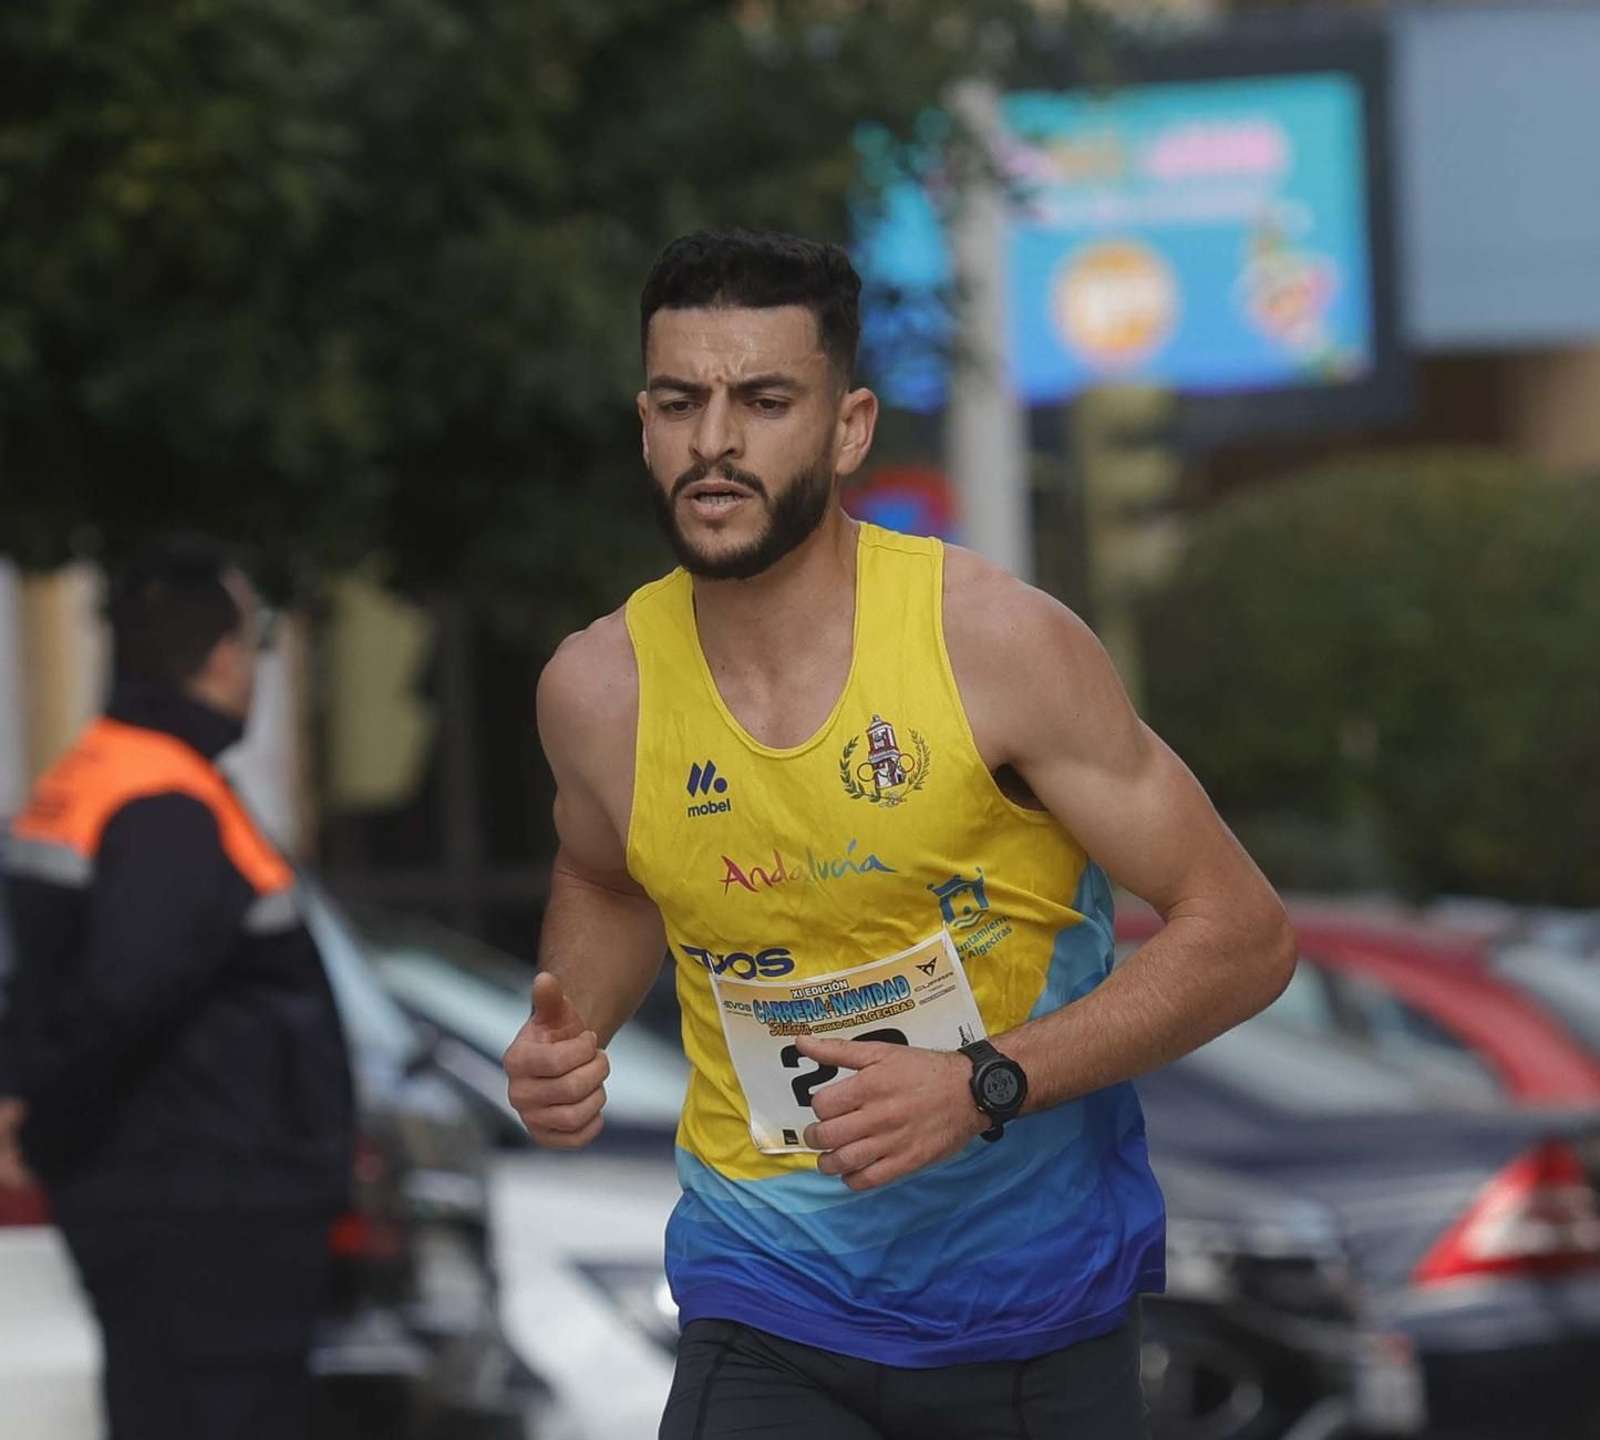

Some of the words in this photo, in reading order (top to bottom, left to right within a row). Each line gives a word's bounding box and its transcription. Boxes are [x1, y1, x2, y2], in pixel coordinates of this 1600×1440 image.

[687, 798, 732, 818] mobel
[719, 839, 898, 896] Andalucía
[968, 926, 1012, 959] Algeciras
[753, 994, 832, 1024] CARRERA
[828, 975, 911, 1018] NAVIDAD
[791, 988, 804, 1000] XI
[804, 979, 850, 998] EDICIÓN
[855, 1000, 916, 1025] ALGECIRAS
[780, 1027, 909, 1108] 2
